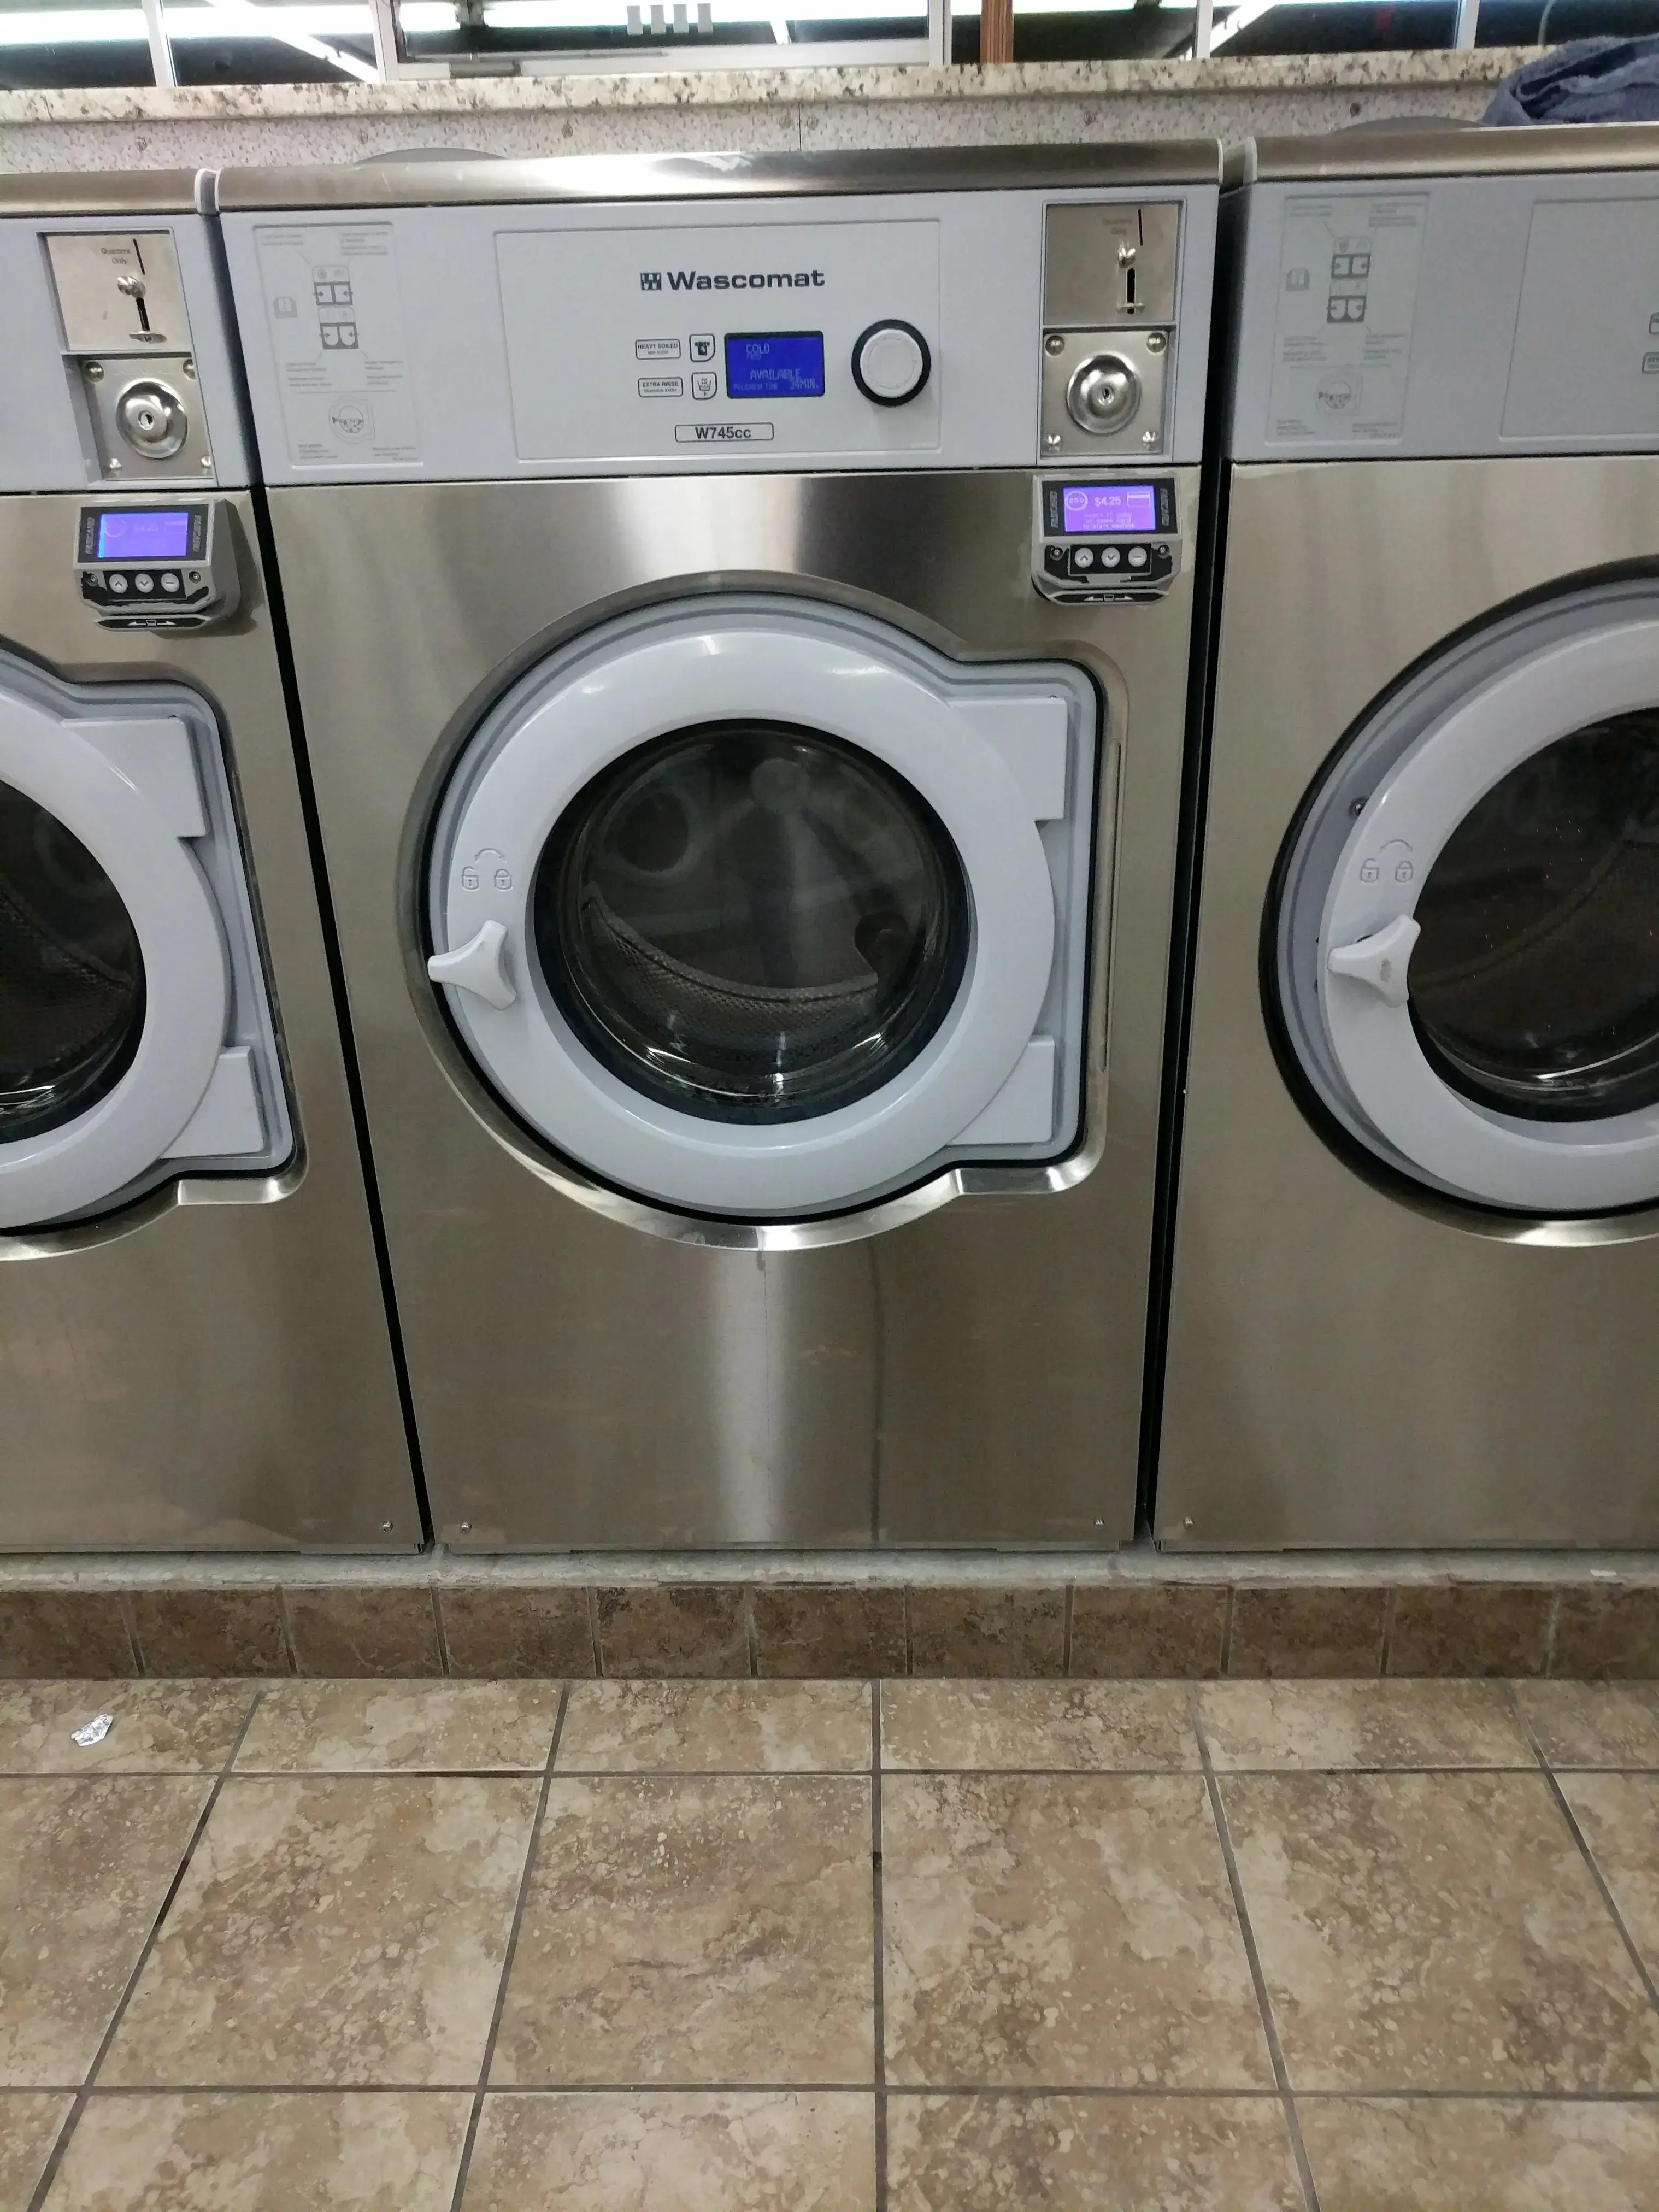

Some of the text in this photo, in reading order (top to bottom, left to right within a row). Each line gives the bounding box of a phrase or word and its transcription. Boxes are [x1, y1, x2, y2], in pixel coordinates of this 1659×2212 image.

[666, 269, 825, 291] Wascomat
[745, 343, 770, 354] COLD
[750, 368, 801, 381] AVAILABLE
[695, 426, 752, 439] W745cc
